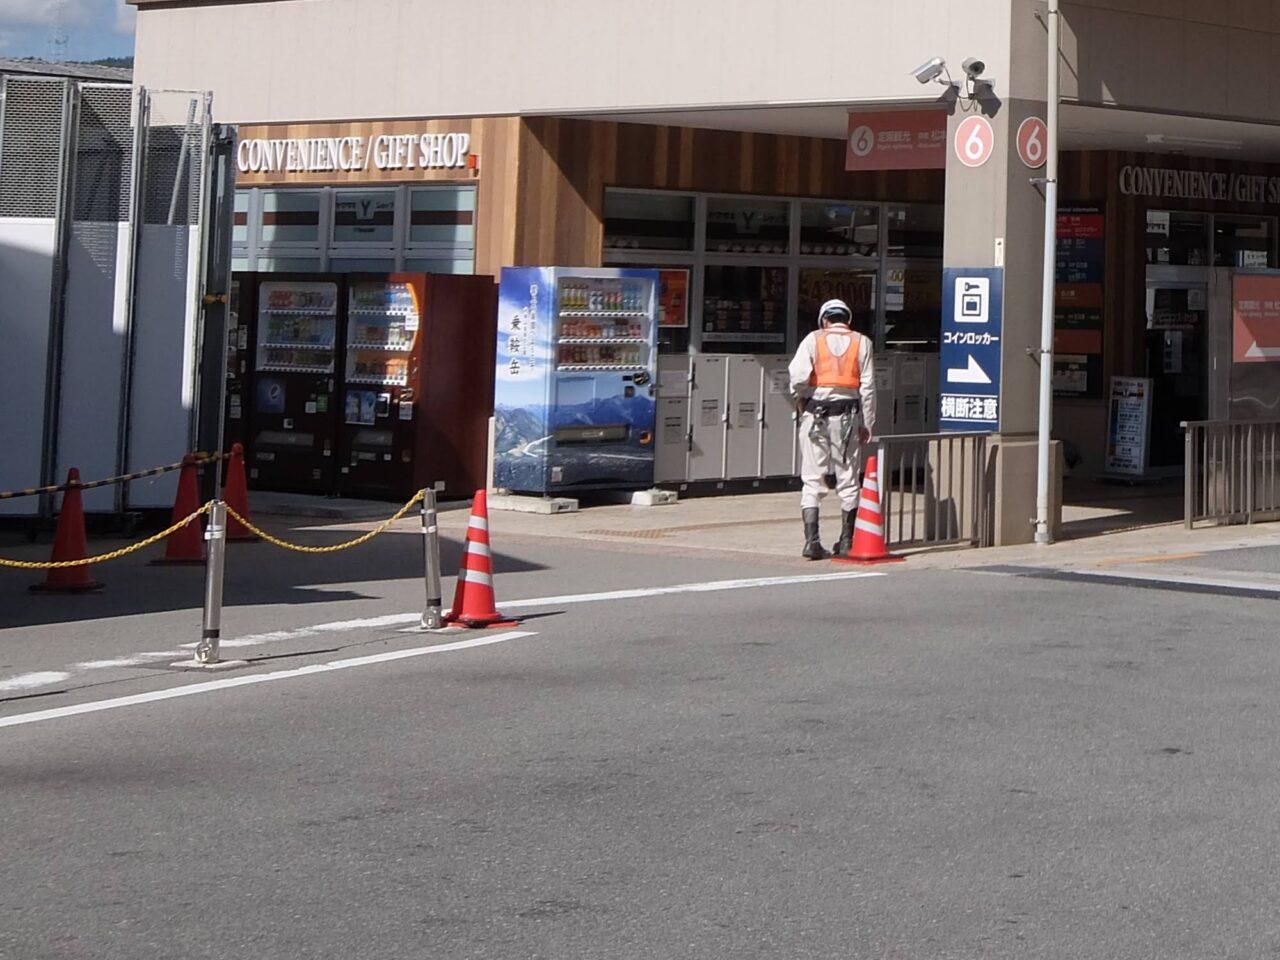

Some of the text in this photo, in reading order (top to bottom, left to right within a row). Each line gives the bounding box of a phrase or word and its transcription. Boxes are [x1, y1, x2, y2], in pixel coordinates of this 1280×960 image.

[237, 136, 363, 171] CONVENIENCE
[374, 134, 419, 170] GIFT
[418, 132, 471, 169] SHOP
[857, 129, 868, 151] 6
[965, 123, 984, 160] 6
[1025, 125, 1042, 161] 6
[1119, 165, 1227, 201] CONVENIENCE
[1235, 174, 1268, 203] GIFT
[943, 332, 1000, 345] コインロッカー
[940, 396, 999, 420] 横断注意
